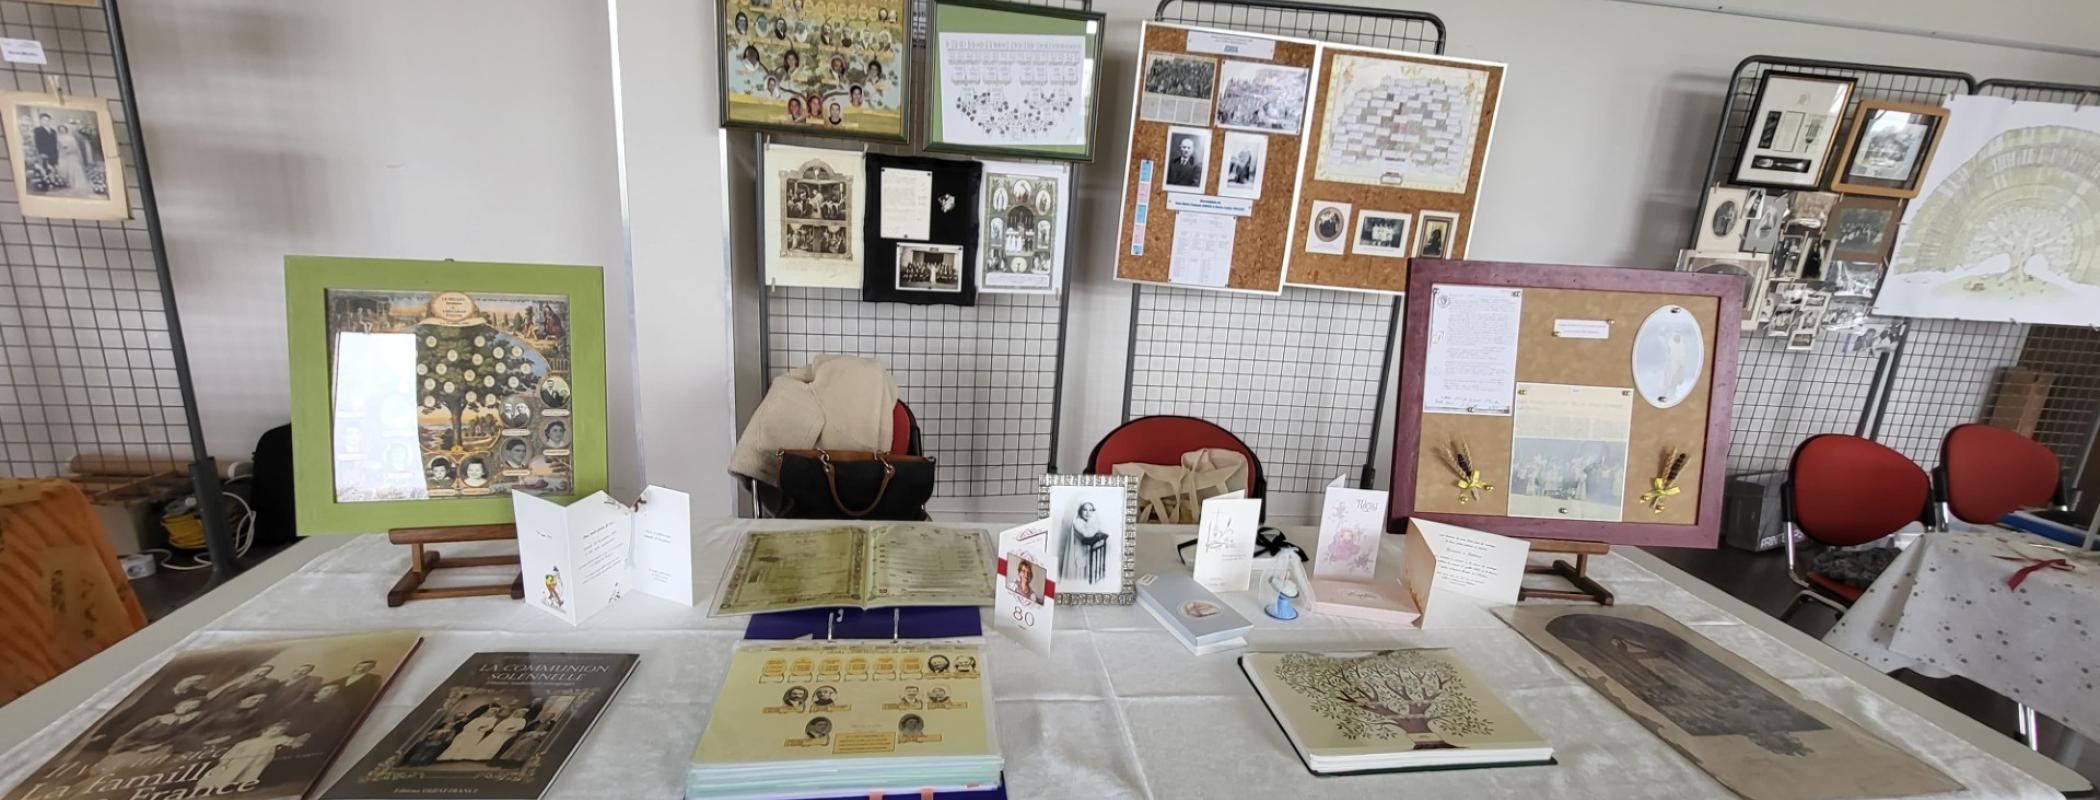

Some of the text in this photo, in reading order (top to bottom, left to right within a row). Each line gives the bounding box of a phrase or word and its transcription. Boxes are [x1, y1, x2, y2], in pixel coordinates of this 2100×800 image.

[1013, 606, 1035, 627] 80
[479, 663, 609, 673] LA COMMUNION
[488, 672, 585, 681] SOLENNELLE
[82, 761, 214, 795] famill
[128, 779, 260, 800] France
